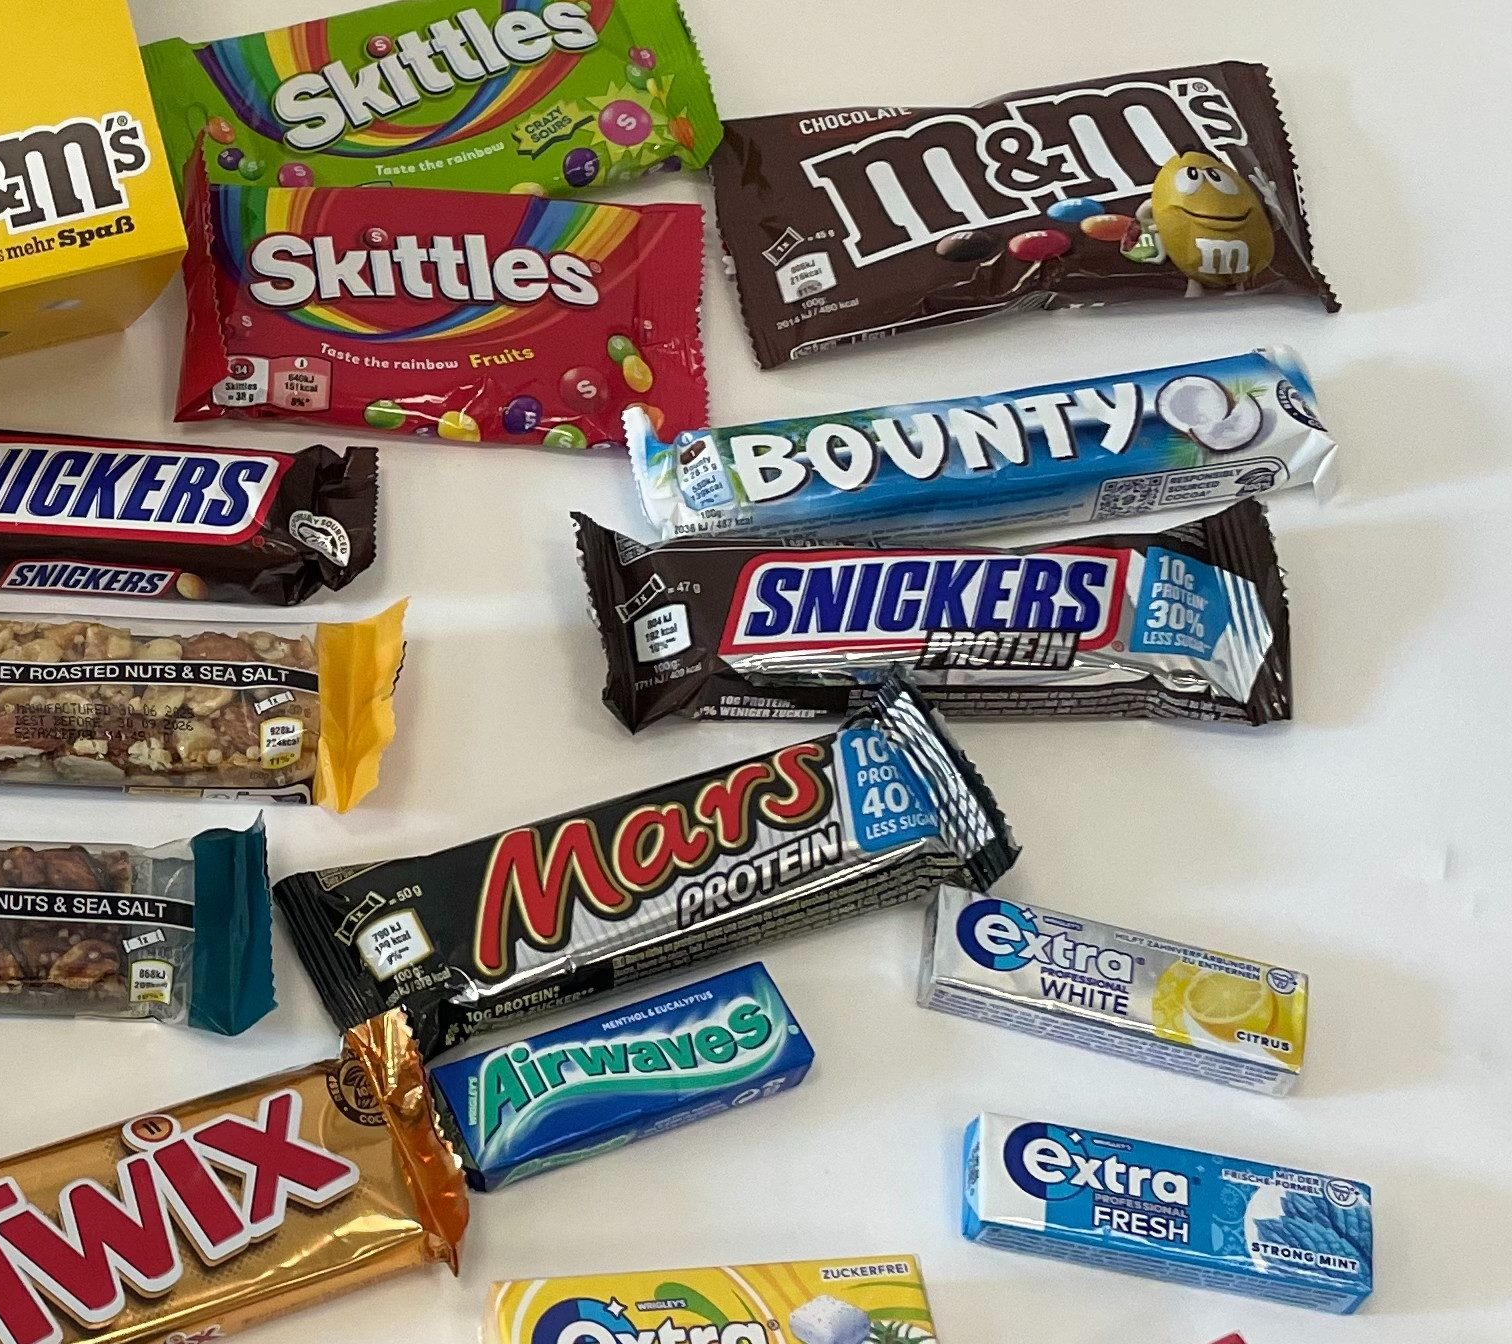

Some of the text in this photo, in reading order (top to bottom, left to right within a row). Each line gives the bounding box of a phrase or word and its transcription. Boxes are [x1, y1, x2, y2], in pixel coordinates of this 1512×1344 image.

[275, 1, 598, 149] Skittles
[525, 106, 564, 133] CRAZY
[530, 115, 573, 144] SOURS
[798, 105, 913, 136] CHOCOLATE
[376, 141, 505, 177] Taste the rainbow
[805, 82, 1245, 264] m&m's
[7, 236, 55, 260] mehr
[57, 216, 135, 248] Spaß
[249, 229, 601, 307] Skittles
[1195, 238, 1250, 274] m
[320, 342, 536, 370] Taste the rainbow Fruits
[729, 383, 1143, 503] BOUNTY
[7, 564, 165, 595] SNICKERS
[746, 556, 1109, 637] SNICKERS
[1146, 600, 1204, 638] 30%
[924, 631, 1076, 669] PROTEIN
[1143, 632, 1173, 646] LESS
[30, 665, 120, 680] ROASTED
[126, 665, 176, 679] NUTS
[181, 666, 194, 679] &
[200, 666, 237, 681] SEA
[242, 667, 289, 683] SALT
[15, 703, 111, 716] MANUFACTURED
[54, 717, 101, 728] BEFORE
[164, 719, 195, 731] 2026
[720, 707, 771, 718] WENIGER
[866, 819, 897, 839] LESS
[477, 745, 824, 970] Mars
[680, 826, 840, 922] PROTEIN
[54, 896, 68, 913] &
[73, 897, 112, 915] SEA
[117, 900, 167, 919] SALT
[396, 885, 423, 902] 50 g
[975, 912, 1134, 984] extra
[1115, 932, 1144, 947] HILFT
[1041, 966, 1129, 995] PROFESSIONAL
[1182, 956, 1261, 981] ZU ENTFERNEN
[602, 1011, 646, 1031] MENTHOL
[656, 990, 713, 1015] EUCALYPTUS
[1040, 977, 1129, 1015] WHITE
[1236, 1031, 1291, 1053] CITRUS
[485, 1003, 772, 1143] Airwaves
[1022, 1137, 1188, 1205] extra
[1223, 1169, 1323, 1196] FRISCHE-FORMEL
[1275, 1169, 1321, 1186] MIT DER
[1095, 1194, 1188, 1217] PROFESSIONAL
[1093, 1208, 1189, 1242] FRESH
[822, 1263, 909, 1280] ZUCKERFREI
[1251, 1242, 1359, 1271] STRONG MINT
